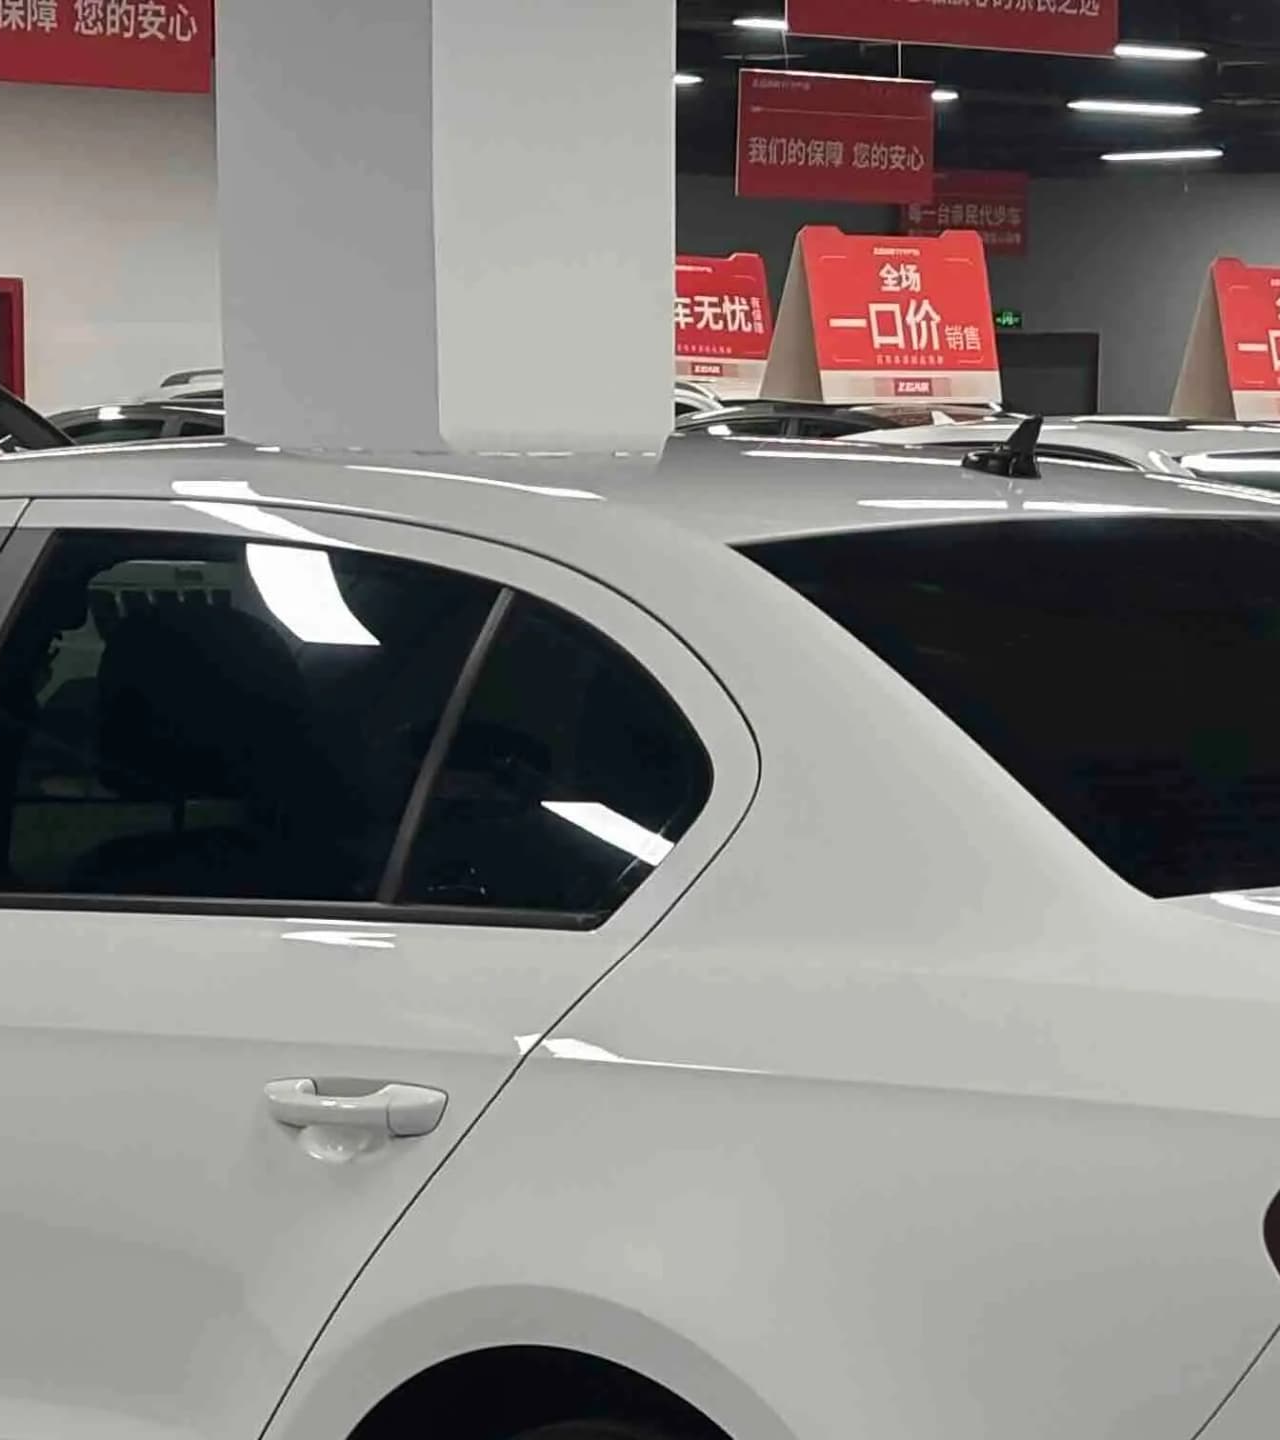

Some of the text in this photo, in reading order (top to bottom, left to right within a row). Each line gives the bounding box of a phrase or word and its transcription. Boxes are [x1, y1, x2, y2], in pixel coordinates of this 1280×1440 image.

[748, 136, 925, 172] 我们的保障 您的安心
[879, 263, 922, 293] 全场
[828, 299, 982, 351] 一口价 销售
